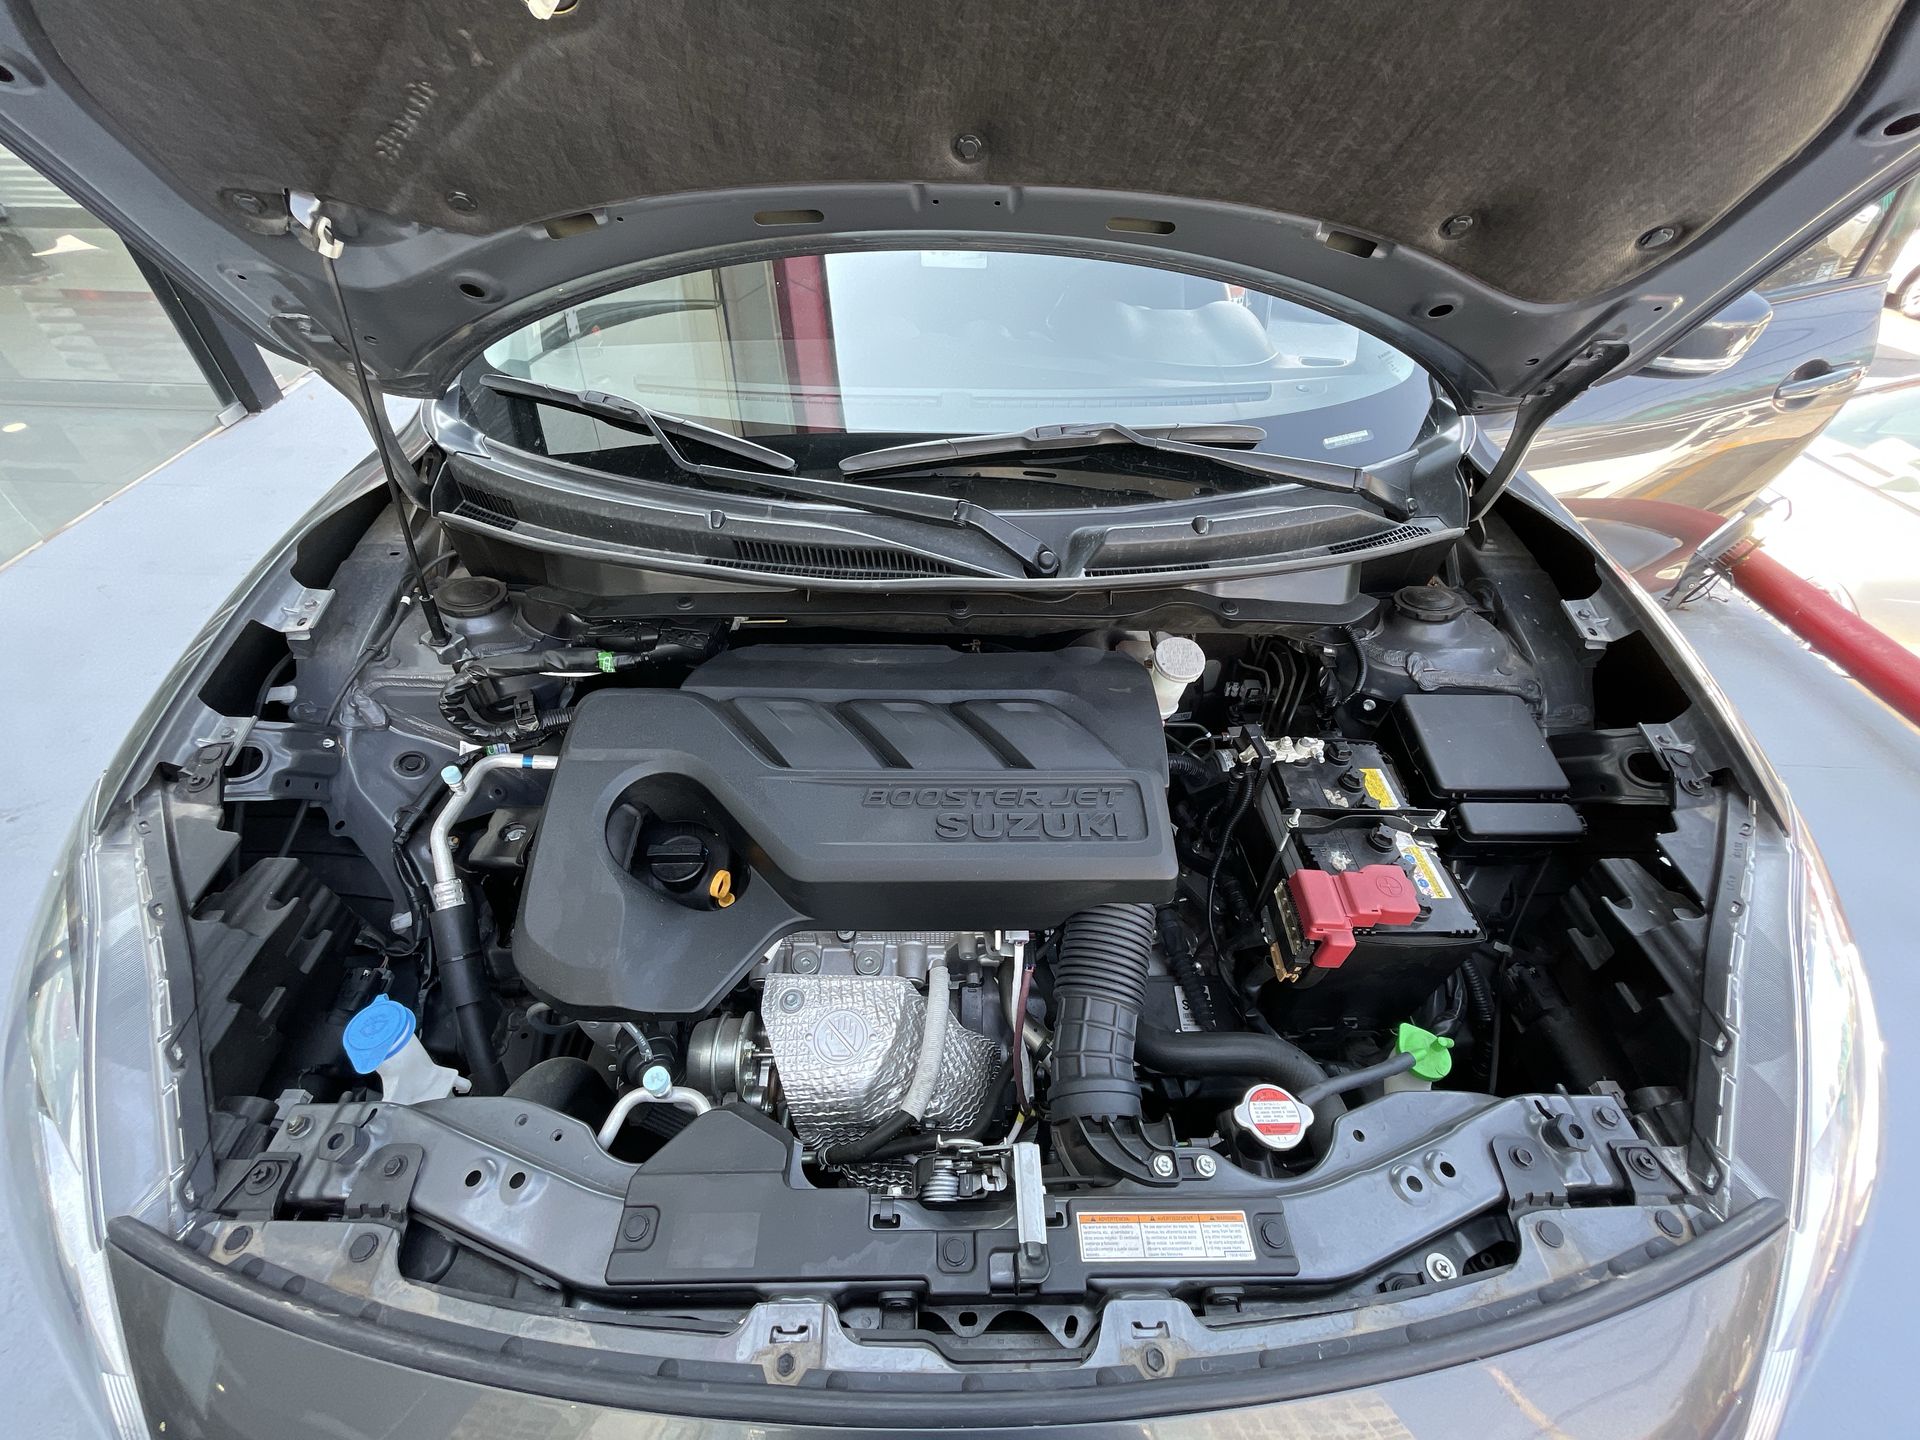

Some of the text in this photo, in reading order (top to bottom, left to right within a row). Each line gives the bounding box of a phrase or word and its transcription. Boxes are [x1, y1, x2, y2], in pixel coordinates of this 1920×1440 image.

[861, 787, 1124, 809] BOOSTER JET
[935, 811, 1129, 840] SUZUKI
